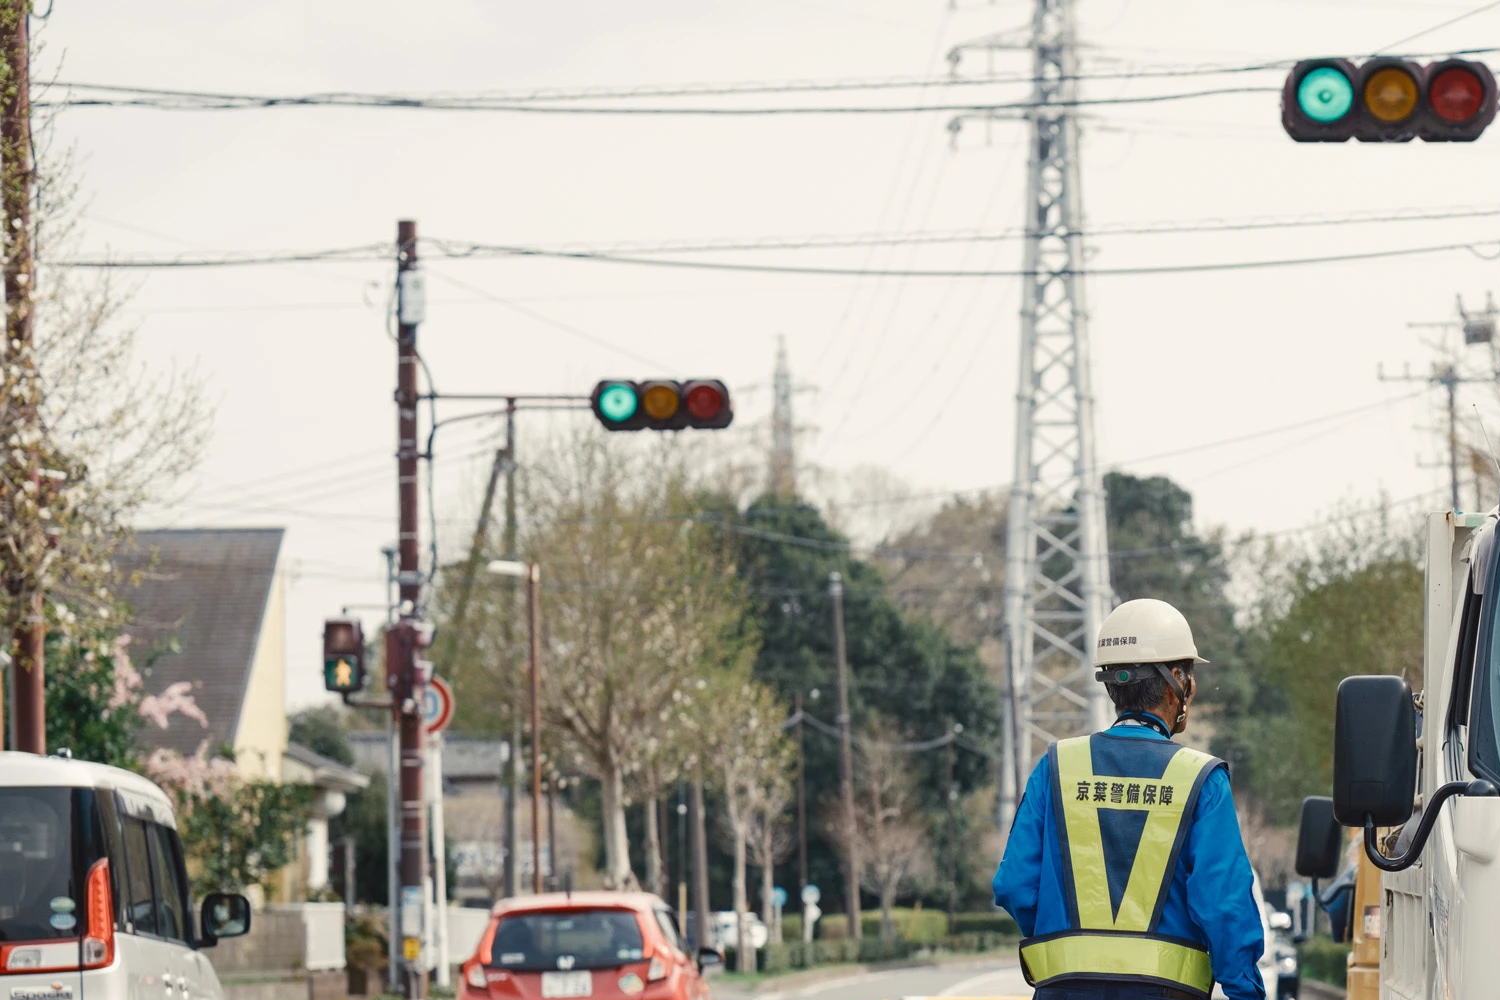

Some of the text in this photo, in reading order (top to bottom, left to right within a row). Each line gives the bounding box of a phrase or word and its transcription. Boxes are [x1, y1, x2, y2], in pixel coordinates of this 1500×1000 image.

[1076, 781, 1173, 805] 京葉警備保障
